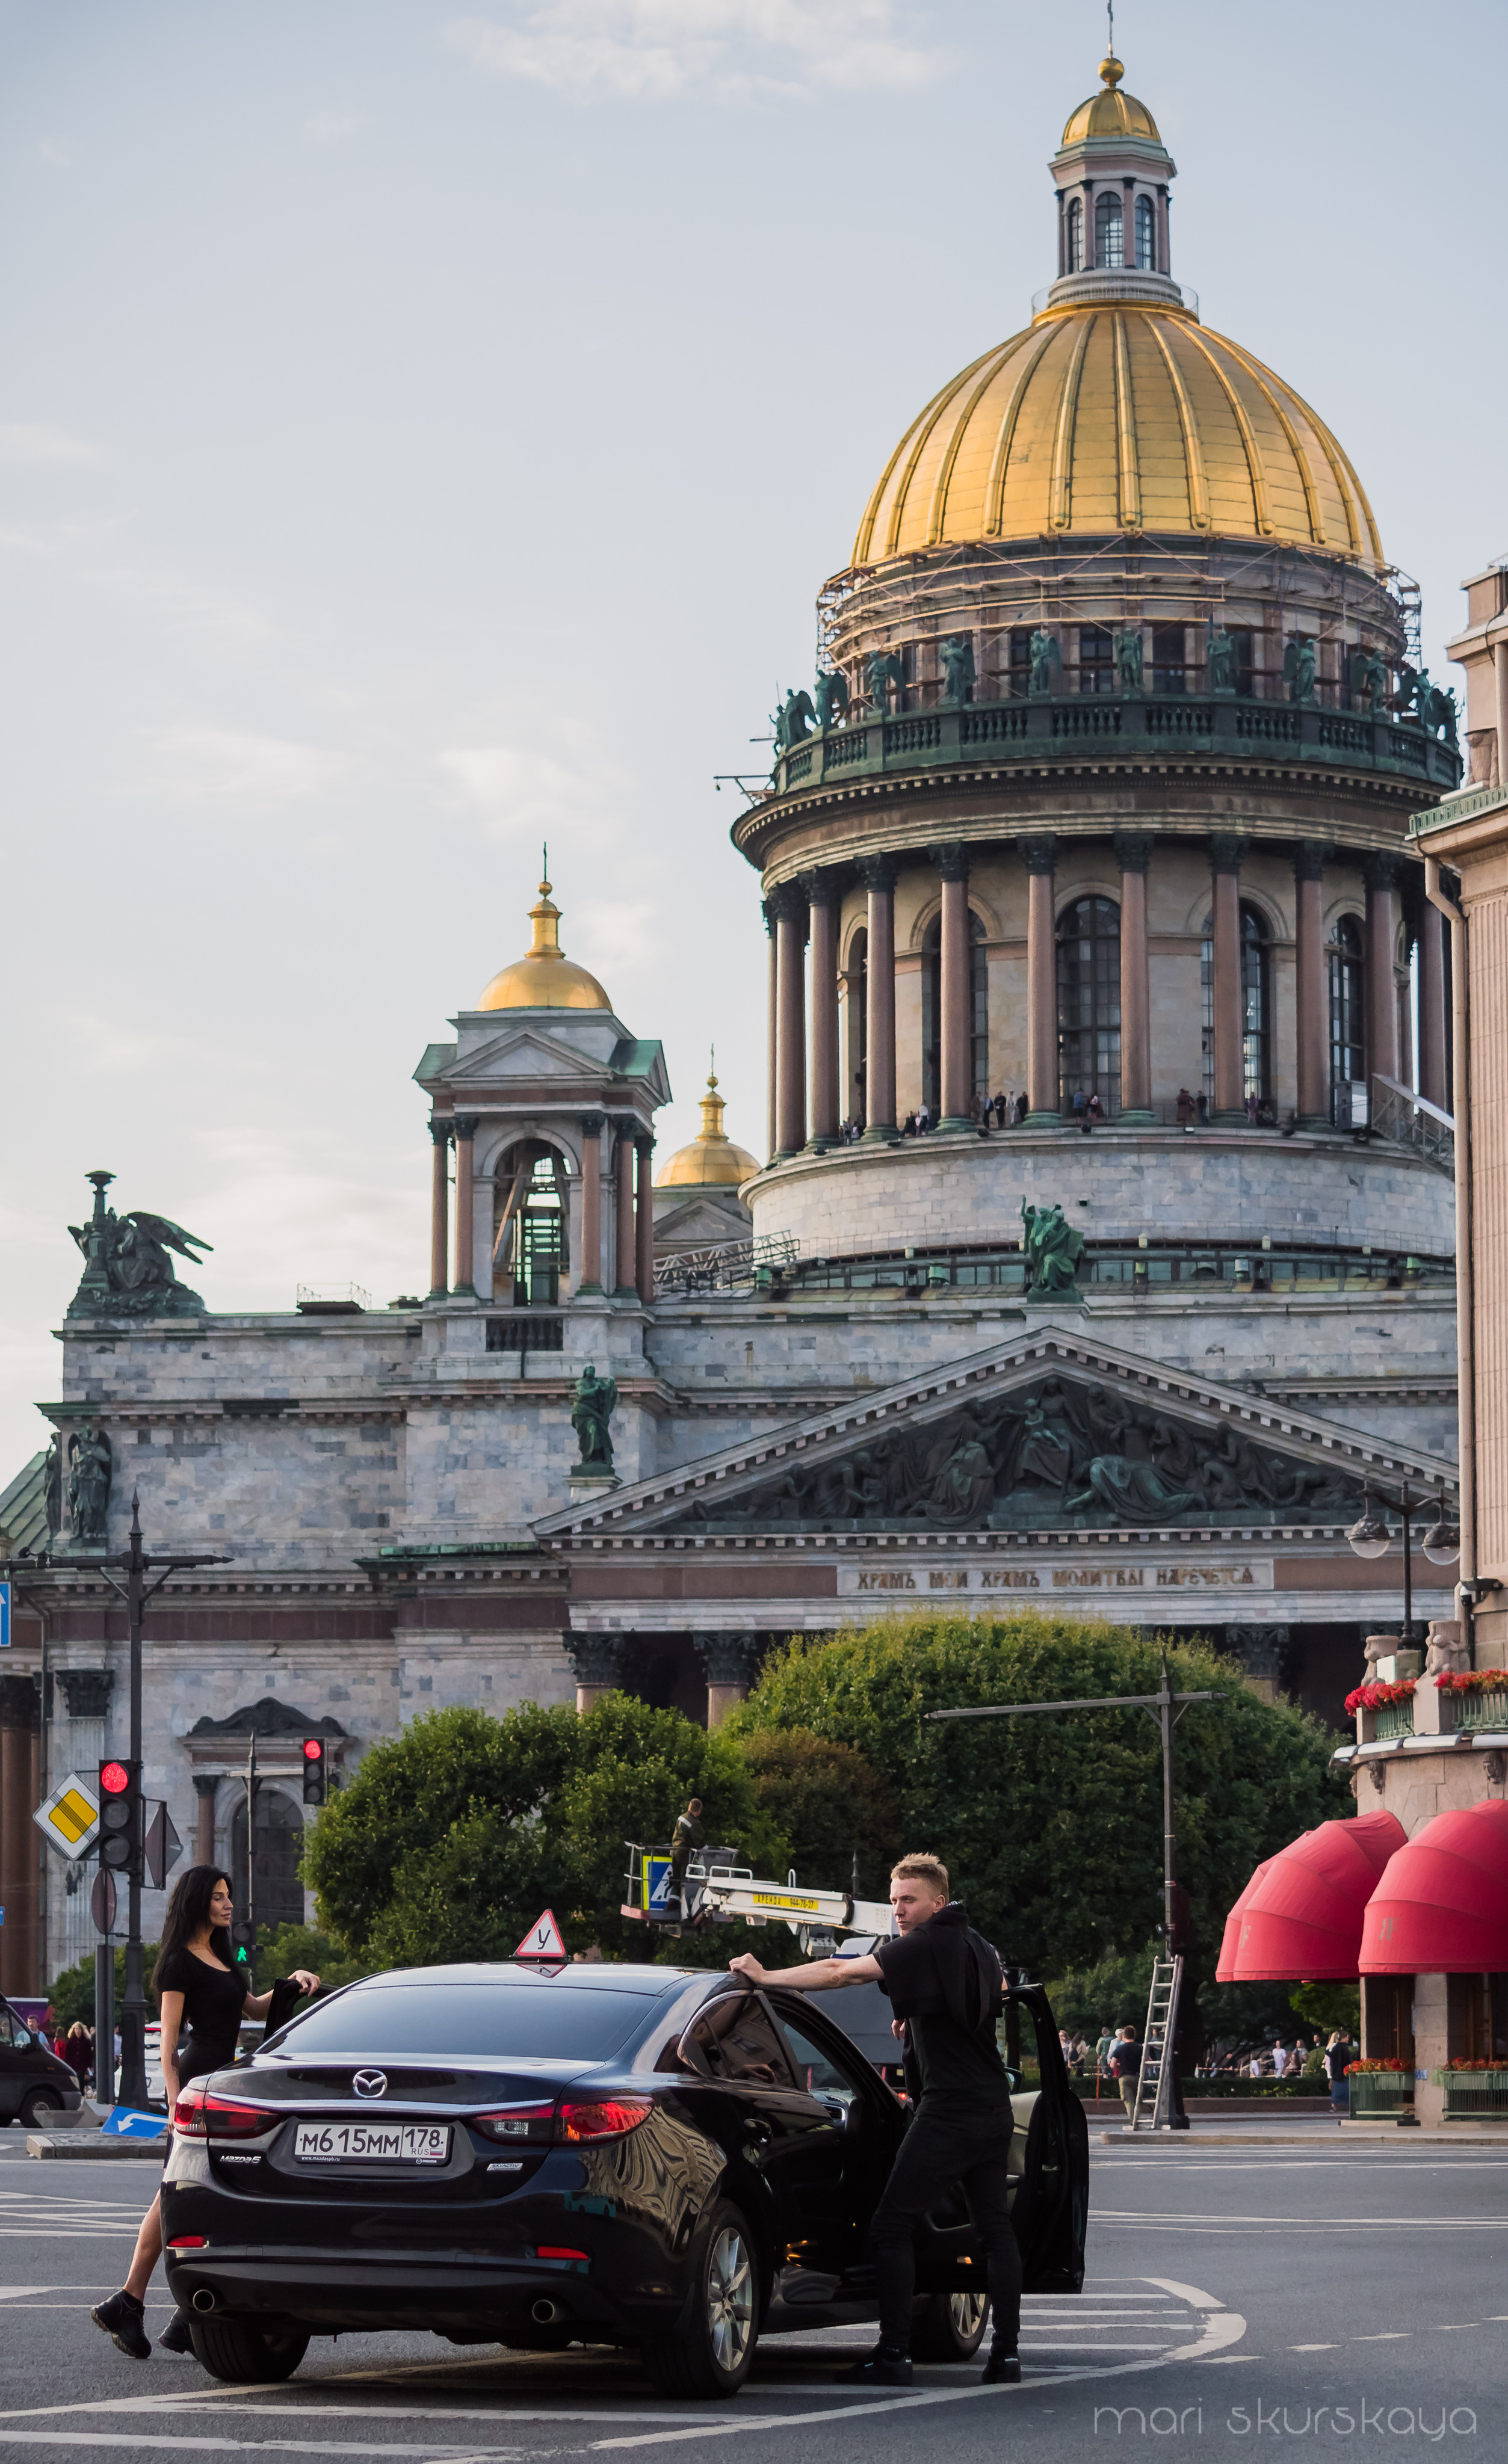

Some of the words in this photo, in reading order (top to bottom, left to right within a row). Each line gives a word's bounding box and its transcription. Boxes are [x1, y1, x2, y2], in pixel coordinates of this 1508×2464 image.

[858, 1572, 916, 1590] ХРАМЪ
[981, 1570, 1040, 1588] ХРАМЪ
[757, 1894, 782, 1906] АРЕНДА
[537, 1929, 551, 1950] У
[404, 2128, 441, 2148] 178
